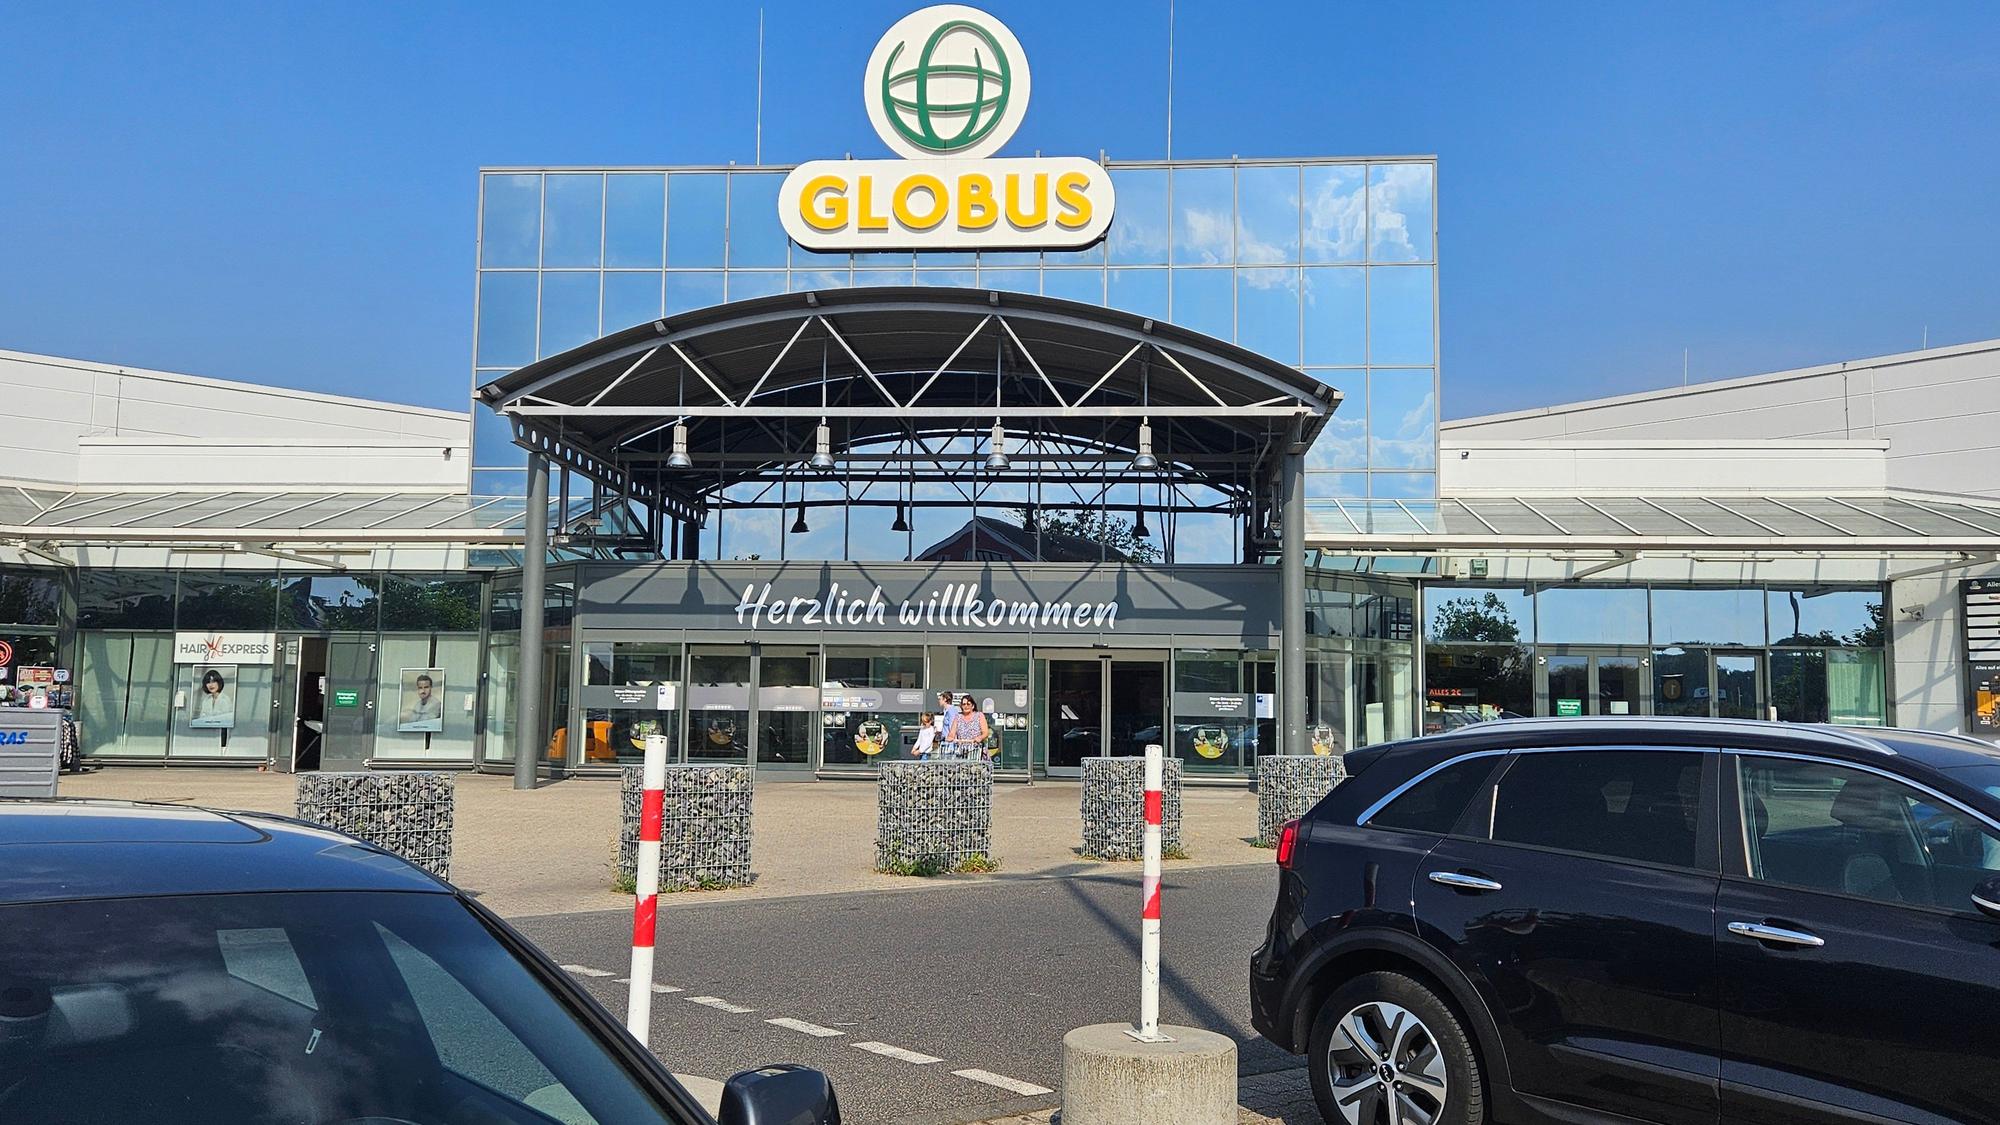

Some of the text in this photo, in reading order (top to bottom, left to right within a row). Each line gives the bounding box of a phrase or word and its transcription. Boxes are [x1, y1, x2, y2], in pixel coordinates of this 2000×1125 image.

[799, 171, 1093, 231] GLOBUS
[734, 582, 1119, 630] Herzlich willkommen
[180, 643, 269, 654] HAIR EXPRESS
[1429, 688, 1449, 697] ALLES
